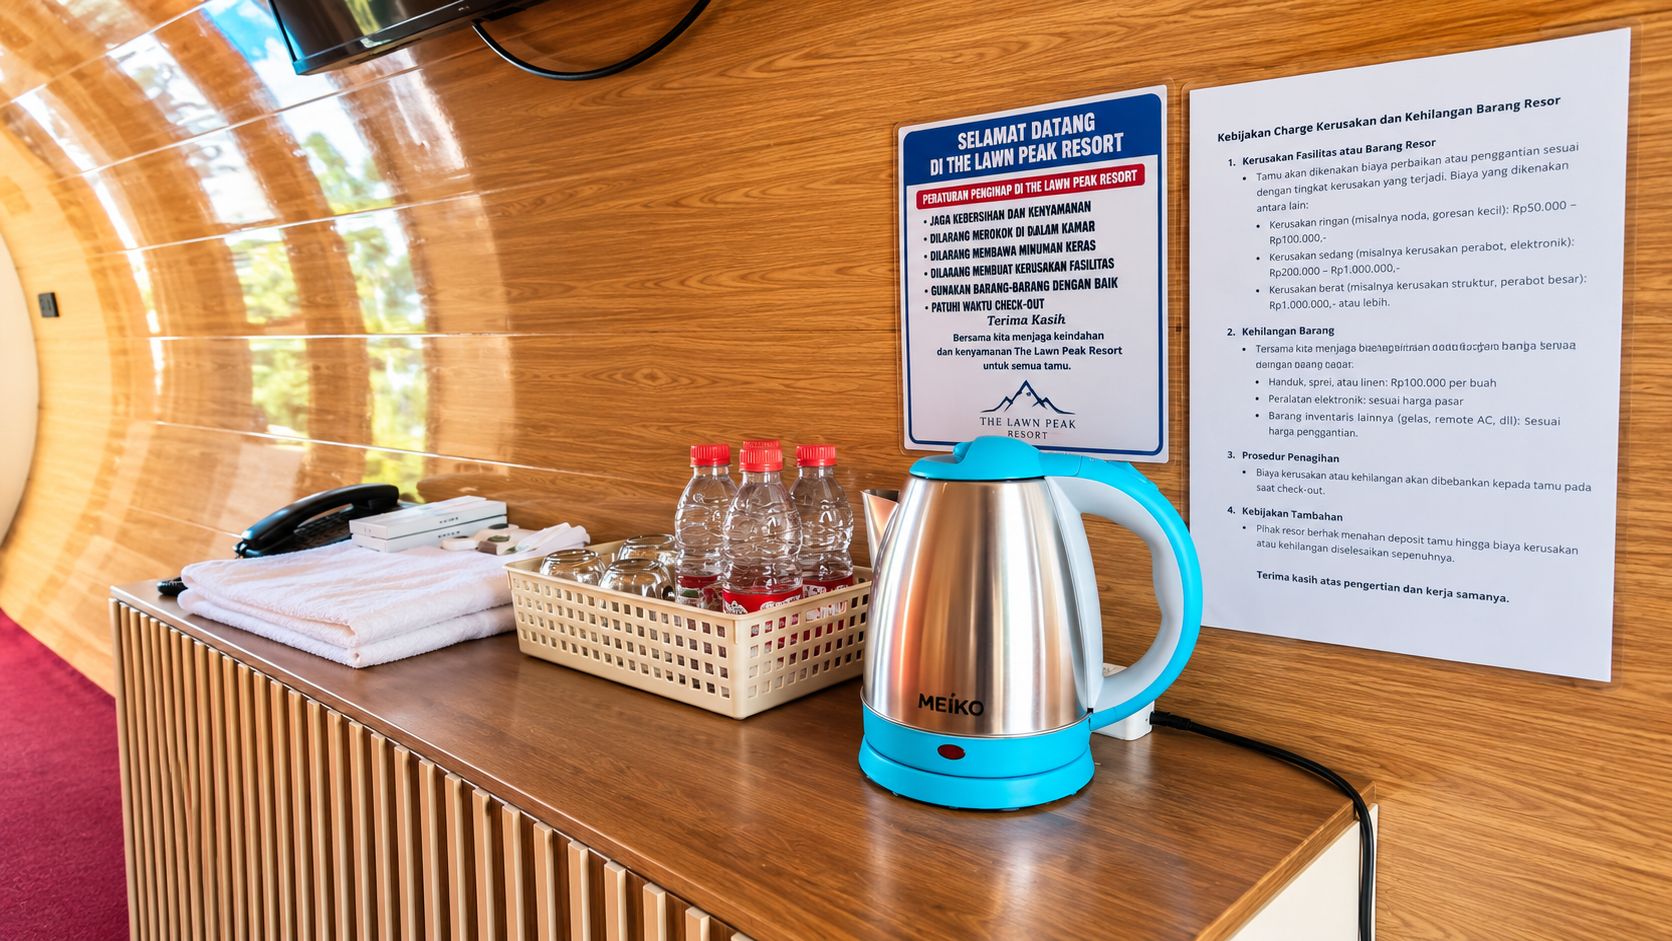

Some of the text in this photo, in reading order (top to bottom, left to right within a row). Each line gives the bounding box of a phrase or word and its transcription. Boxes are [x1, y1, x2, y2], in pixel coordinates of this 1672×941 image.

[1217, 96, 1561, 143] Kebijakan Charge Kerusakan dan Kehilangan Barang Resor
[958, 112, 1095, 149] SELAMAT DATANG
[931, 132, 1124, 175] DI THE LAWN PEAK RESORT
[1227, 139, 1436, 167] 1. Kerusakan Fasilitas atau Barang Resor
[1255, 143, 1579, 181] Tamu akan dikenakan biaya perbaikan atau penggantian sesuai
[922, 169, 1138, 204] PERATURAN DI THE LAWN PEAK RESORT
[929, 199, 1091, 227] JAGA KEBERSIHAN DAN KENYAMANAN
[1256, 200, 1309, 213] antara lain:
[1269, 218, 1317, 230] Kerusakan
[1318, 217, 1349, 228] ringan
[1351, 213, 1398, 226] (misalnya
[1432, 209, 1474, 222] goresan
[1477, 204, 1509, 216] kecil):
[1512, 200, 1567, 215] Rp50.000
[929, 219, 1095, 244] DILARANG MEROKOK DI KAMAR
[930, 239, 1096, 262] DILARANG MEMBAWA MINUMAN KERAS
[1269, 251, 1317, 262] Kerusakan
[1318, 249, 1354, 261] sedang
[1355, 247, 1403, 259] (misalnya
[1405, 244, 1458, 256] kerusakan
[1509, 236, 1574, 250] elektronik):
[972, 257, 1115, 277] MEMBUAT KERUSAKAN FASILITAS
[1269, 265, 1321, 279] Rp200.000
[930, 276, 1118, 296] GUNAKAN BARANG-BARANG DENGAN BAIK
[931, 297, 1045, 313] PATUHI WAKTU CHECK-OUT
[1338, 299, 1360, 308] atau
[1362, 297, 1390, 307] lebih.
[986, 313, 1066, 326] Terima Kasih
[952, 330, 1105, 343] Bersama kita menjaga keindahan
[1226, 326, 1335, 338] 2. Kehilangan Barang
[936, 345, 1123, 358] dan kenyamanan The Lawn Peak Resort
[982, 360, 1071, 371] untuk semua tamu.
[1268, 377, 1307, 387] Handuk,
[1336, 378, 1359, 387] atau
[1360, 377, 1388, 387] linen:
[1390, 377, 1447, 389] Rp100.000
[1448, 379, 1467, 390] per
[1469, 377, 1497, 388] buah
[1268, 393, 1464, 408] Peralatan elektronik: sesuai harga pasar
[979, 416, 1076, 429] THE LAWN PEAK
[1268, 410, 1302, 423] Barang
[1304, 411, 1354, 422] inventaris
[1357, 412, 1394, 425] lainnya
[1434, 415, 1474, 425] remote
[1476, 415, 1496, 426] AC,
[1498, 415, 1520, 427] dll):
[1524, 416, 1561, 426] Sesuai
[1007, 429, 1048, 440] RESORT
[1268, 426, 1358, 439] harga penggantian.
[1227, 450, 1340, 464] 3. Prosedur Penagihan
[1256, 483, 1326, 495] saat check-out.
[1226, 505, 1343, 522] 4. Kebijakan Tambahan
[1281, 527, 1305, 536] resor
[1306, 527, 1339, 538] berhak
[1340, 531, 1386, 542] menahan
[1387, 533, 1425, 545] deposit
[1426, 536, 1453, 547] tamu
[1455, 537, 1490, 551] hingga
[1492, 539, 1521, 553] biaya
[1523, 542, 1579, 555] kerusakan
[1255, 539, 1455, 564] atau kehilangan diselesaikan sepenuhnya.
[1256, 570, 1509, 604] Terima kasih atas pengertian dan kerja samanya.
